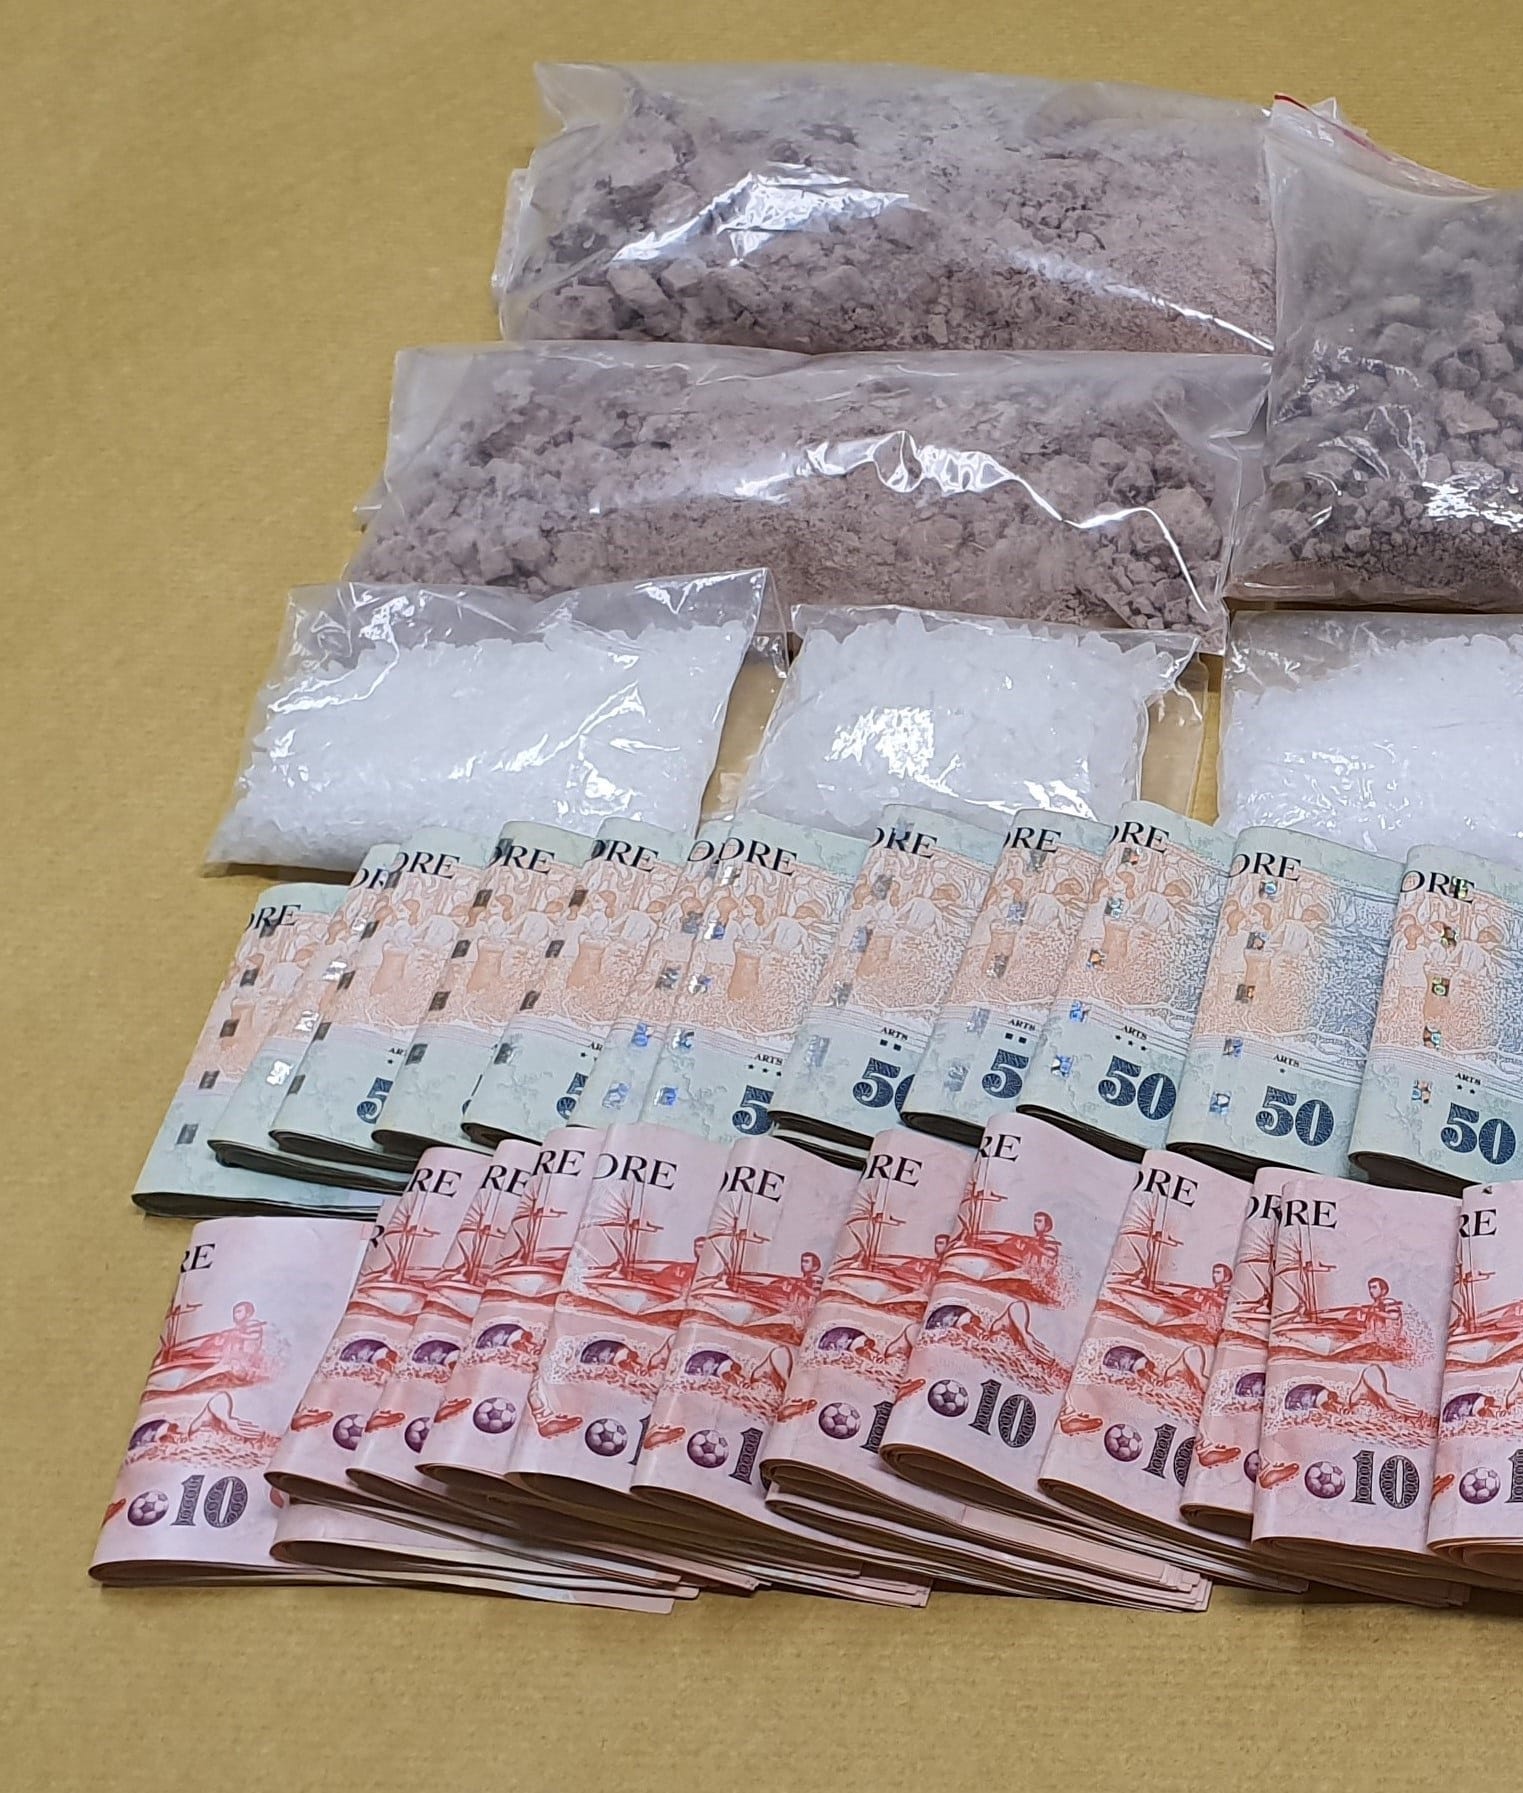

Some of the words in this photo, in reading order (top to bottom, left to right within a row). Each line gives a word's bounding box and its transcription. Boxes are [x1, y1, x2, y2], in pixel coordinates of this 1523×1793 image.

[1400, 869, 1475, 904] ORE
[881, 1026, 909, 1041] ARTS
[1122, 1024, 1148, 1041] ARTS
[1097, 1055, 1177, 1121] 50
[1454, 1071, 1482, 1086] ARTS
[1255, 1085, 1335, 1147] 50
[1440, 1101, 1517, 1166] 50
[969, 1378, 1038, 1448] 10
[170, 1474, 248, 1528] 10
[1350, 1449, 1420, 1510] 10
